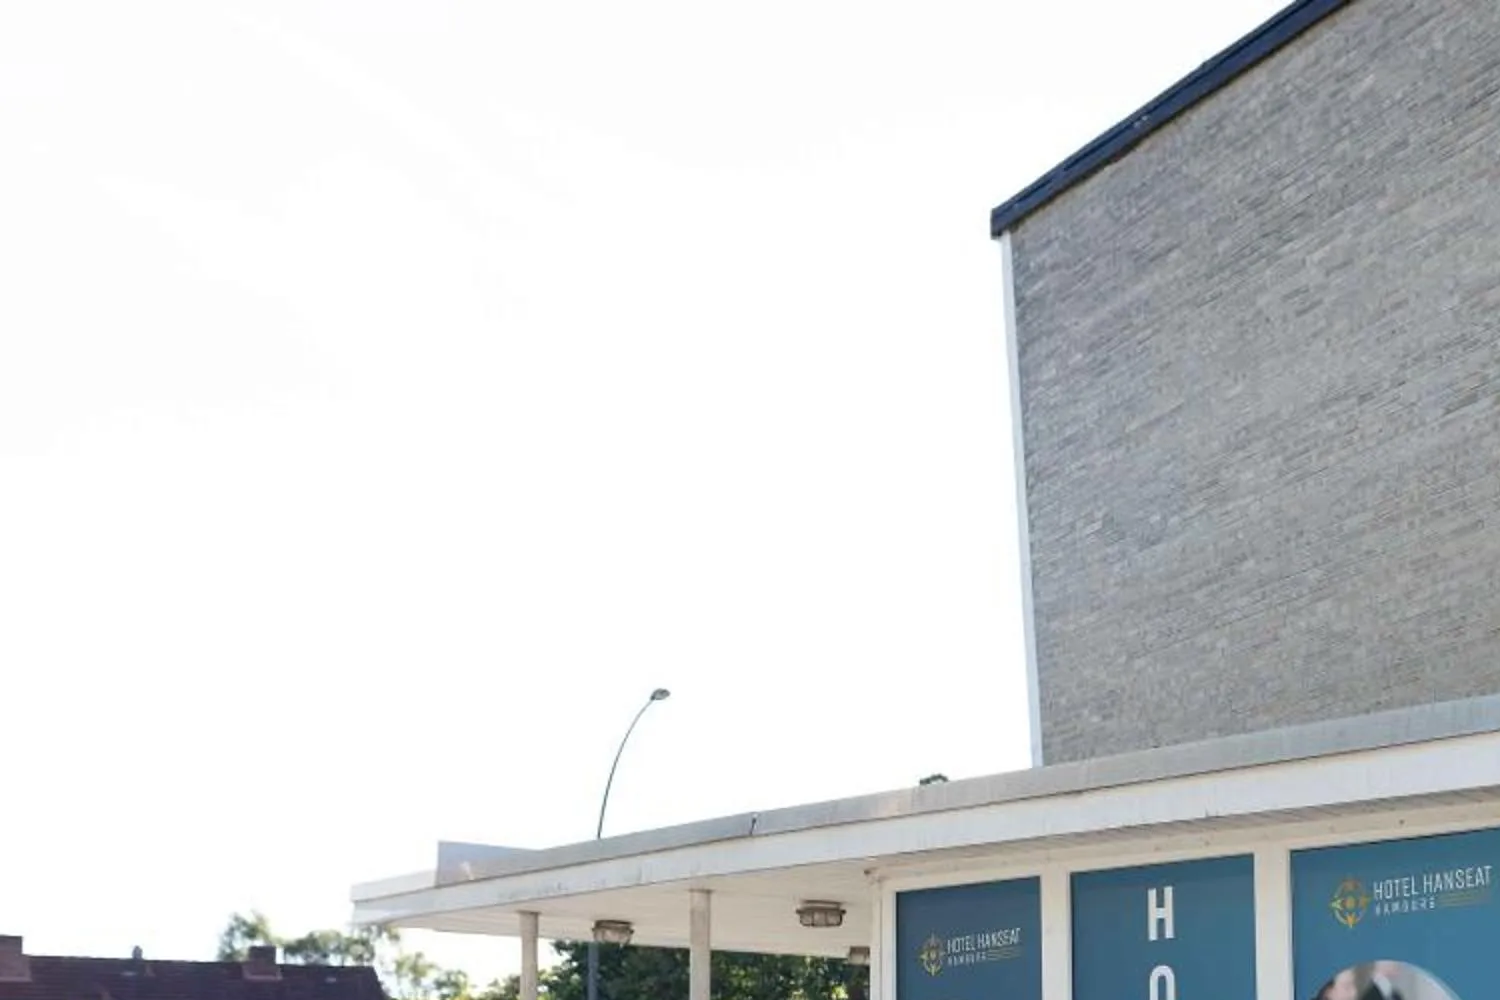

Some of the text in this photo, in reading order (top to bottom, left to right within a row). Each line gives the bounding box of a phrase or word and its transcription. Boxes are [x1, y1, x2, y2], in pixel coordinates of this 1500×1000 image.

[1373, 865, 1492, 900] HOTEL HANSEAT
[947, 927, 1021, 954] HOTEL HANSEAT
